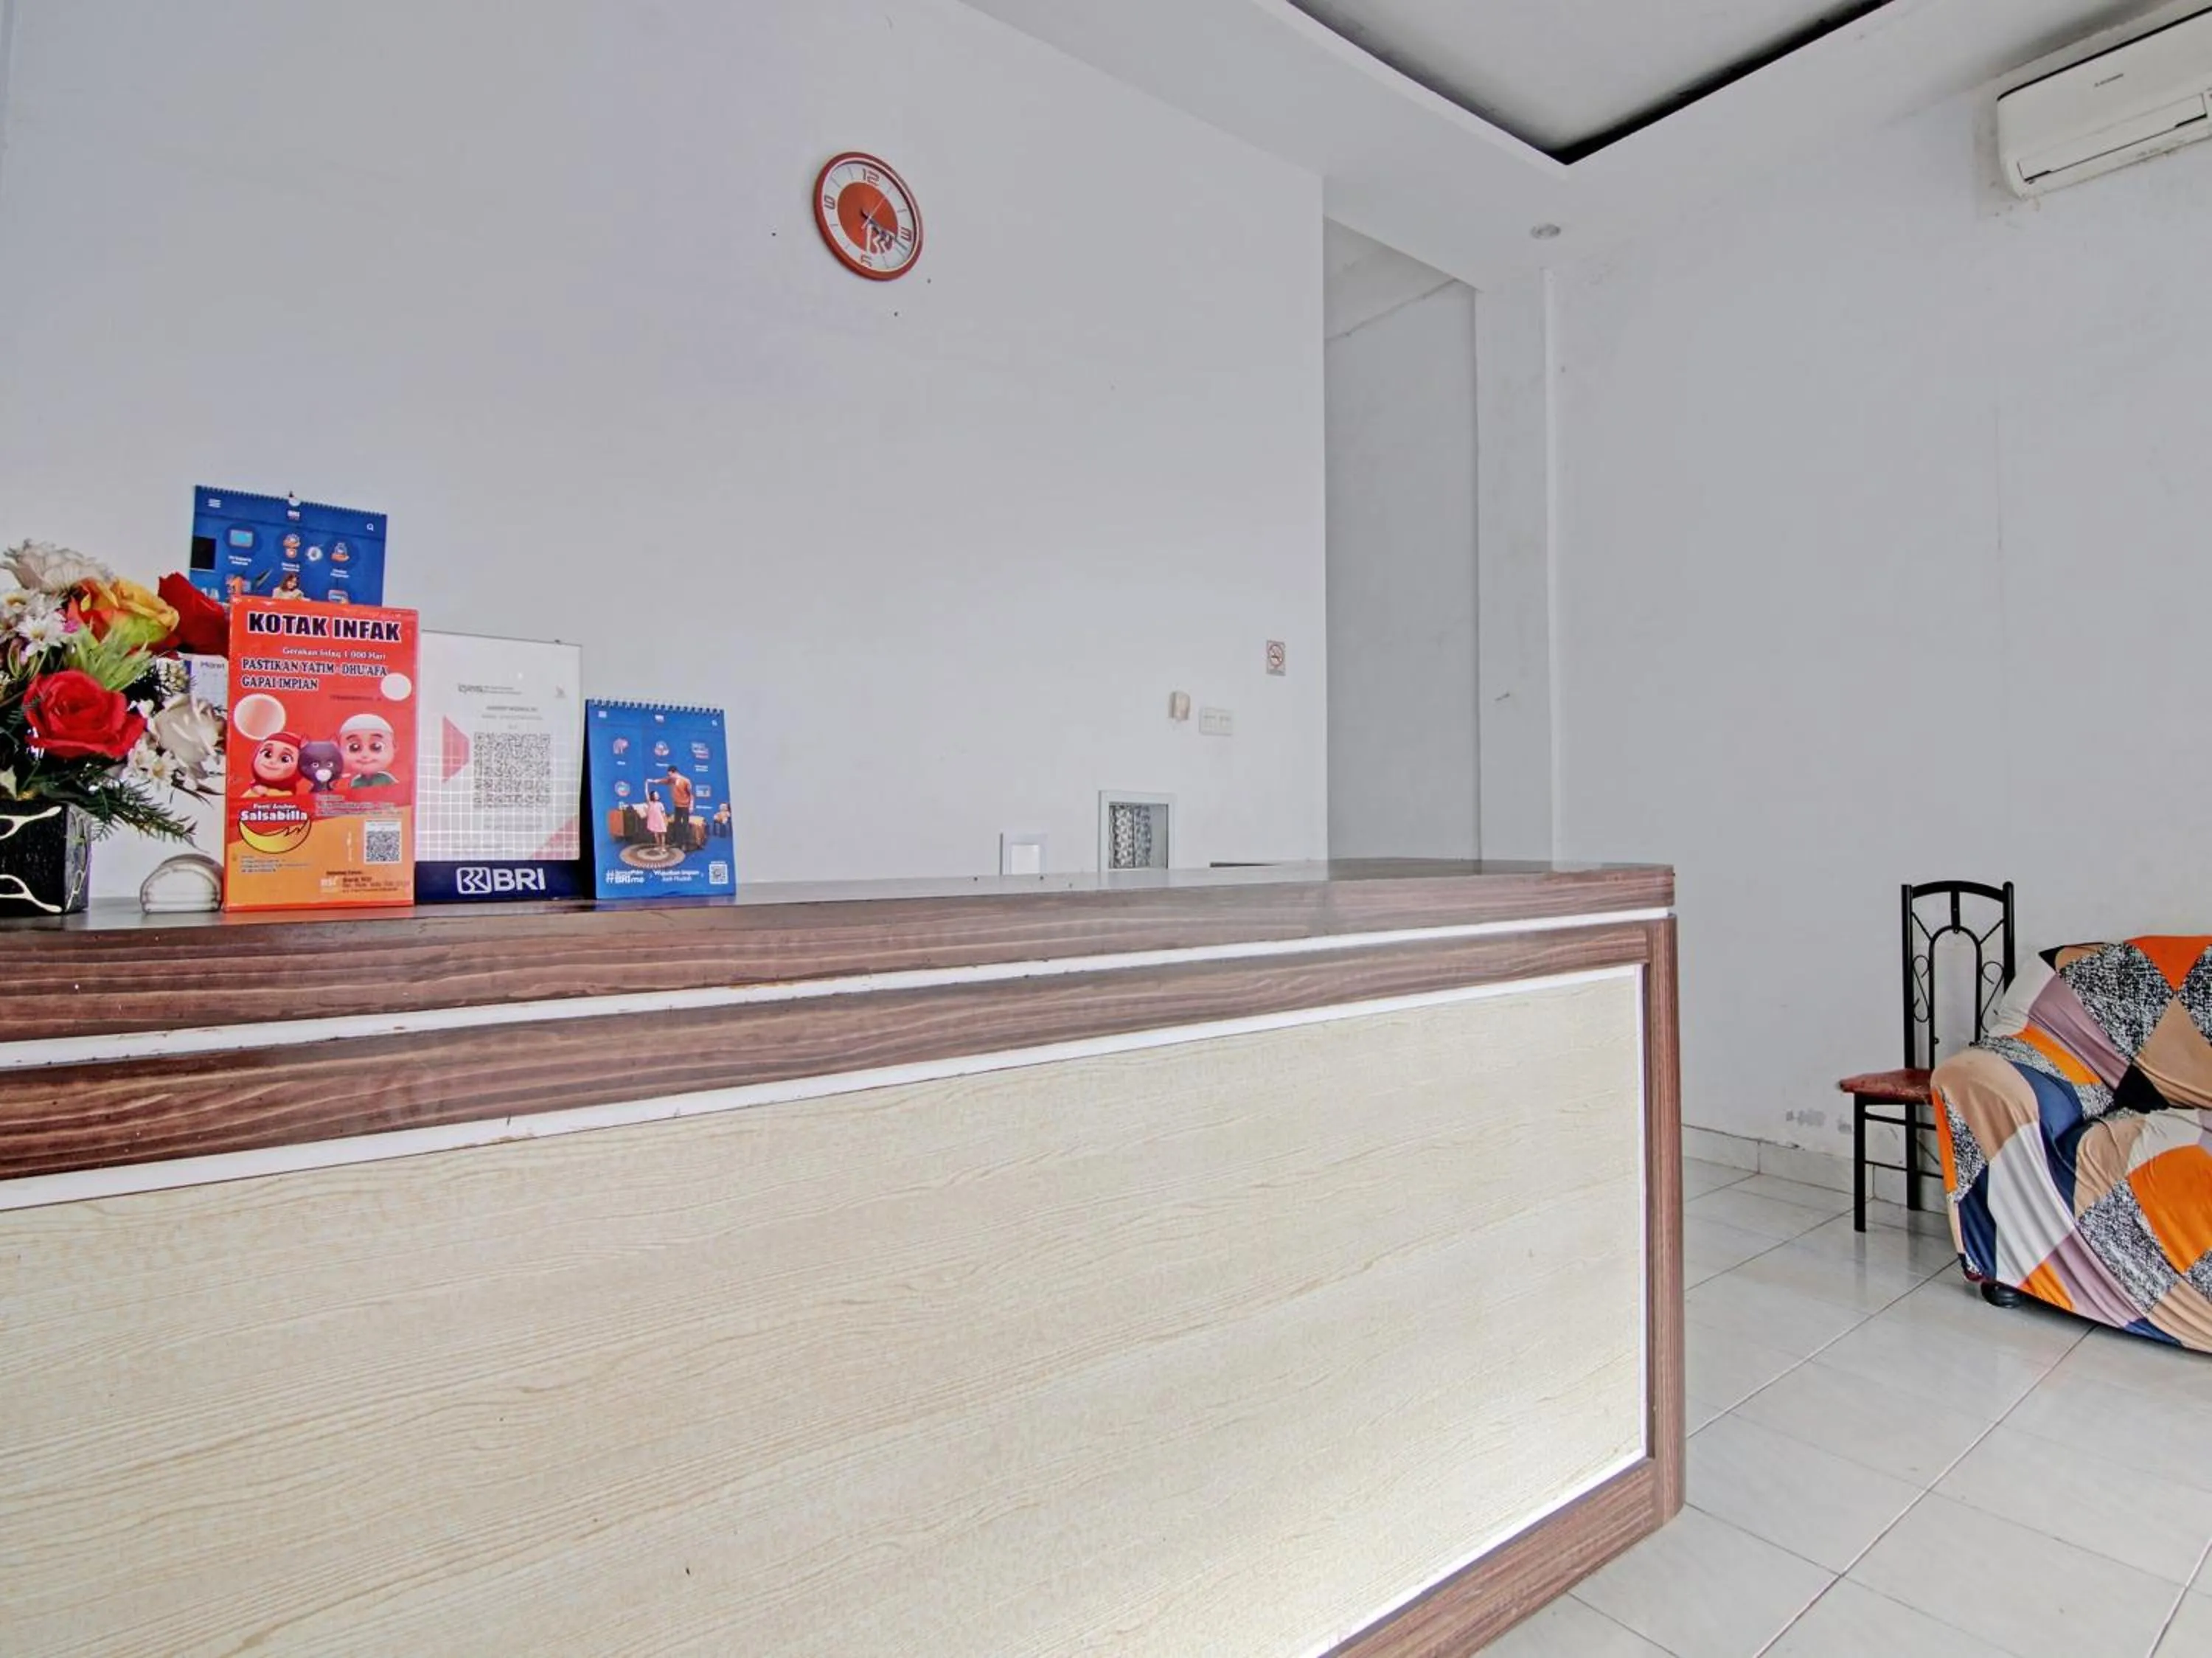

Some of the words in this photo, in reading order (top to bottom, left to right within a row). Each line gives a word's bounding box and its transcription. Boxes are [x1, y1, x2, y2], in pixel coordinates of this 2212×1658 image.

[862, 168, 880, 186] 12
[248, 611, 328, 637] KOTAK
[333, 617, 401, 642] INFAK
[283, 648, 318, 656] Gerakan
[242, 659, 299, 672] PASTIKAN
[302, 661, 335, 673] YATIM
[242, 676, 276, 688] GAPAI
[279, 677, 319, 690] IMPIAN
[492, 867, 546, 891] BRI
